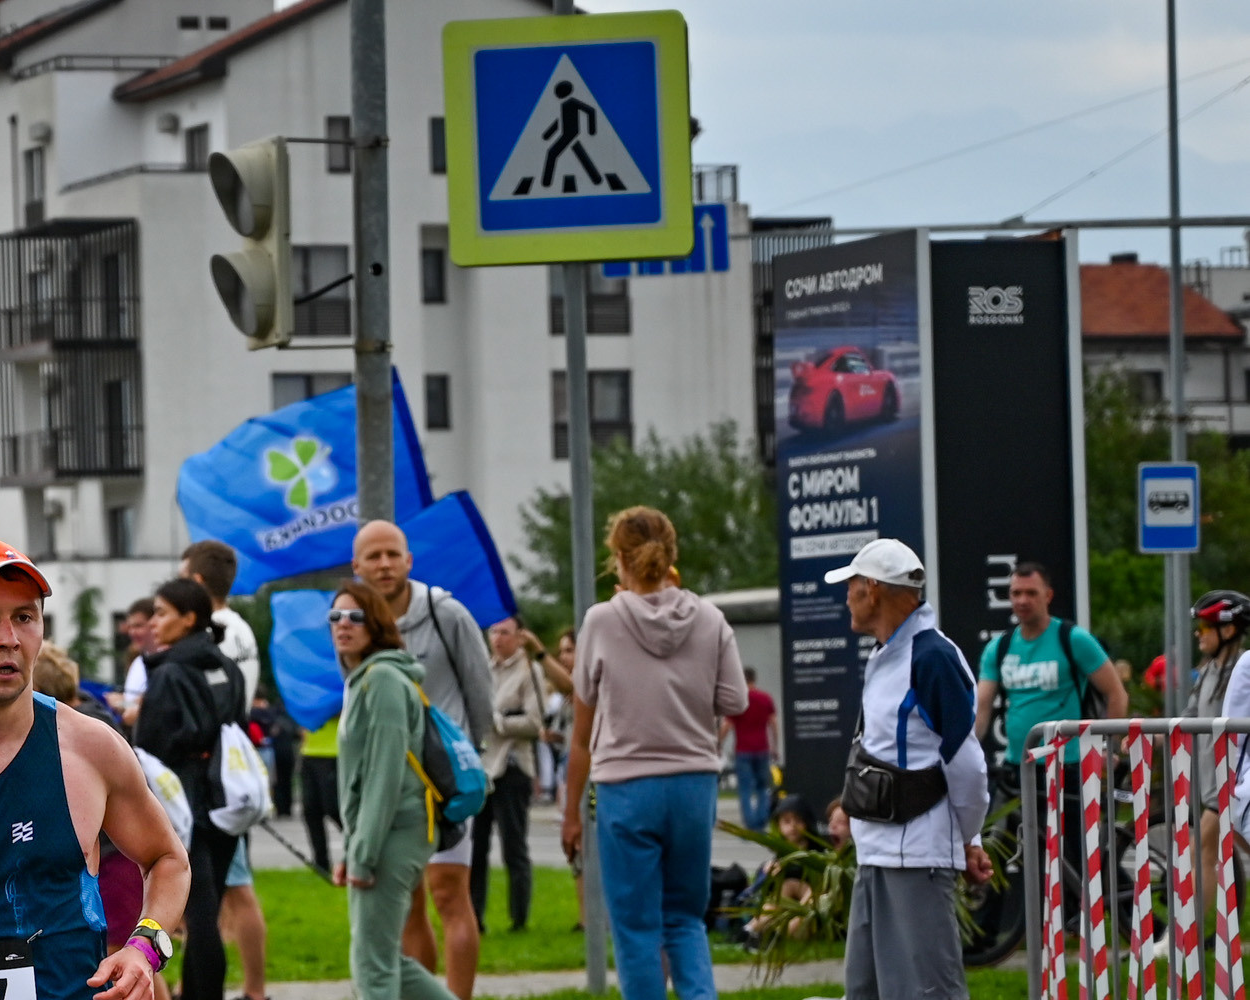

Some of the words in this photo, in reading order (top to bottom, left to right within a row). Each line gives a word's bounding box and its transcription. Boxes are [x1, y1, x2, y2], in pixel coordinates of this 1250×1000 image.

[785, 275, 818, 299] СОЧИ
[818, 262, 884, 293] АВТОДРОМ
[968, 286, 1024, 314] ROS
[788, 472, 800, 499] С
[801, 465, 860, 498] МИРОМ
[788, 497, 868, 532] ФОРМУЛЫ
[870, 496, 878, 523] 1
